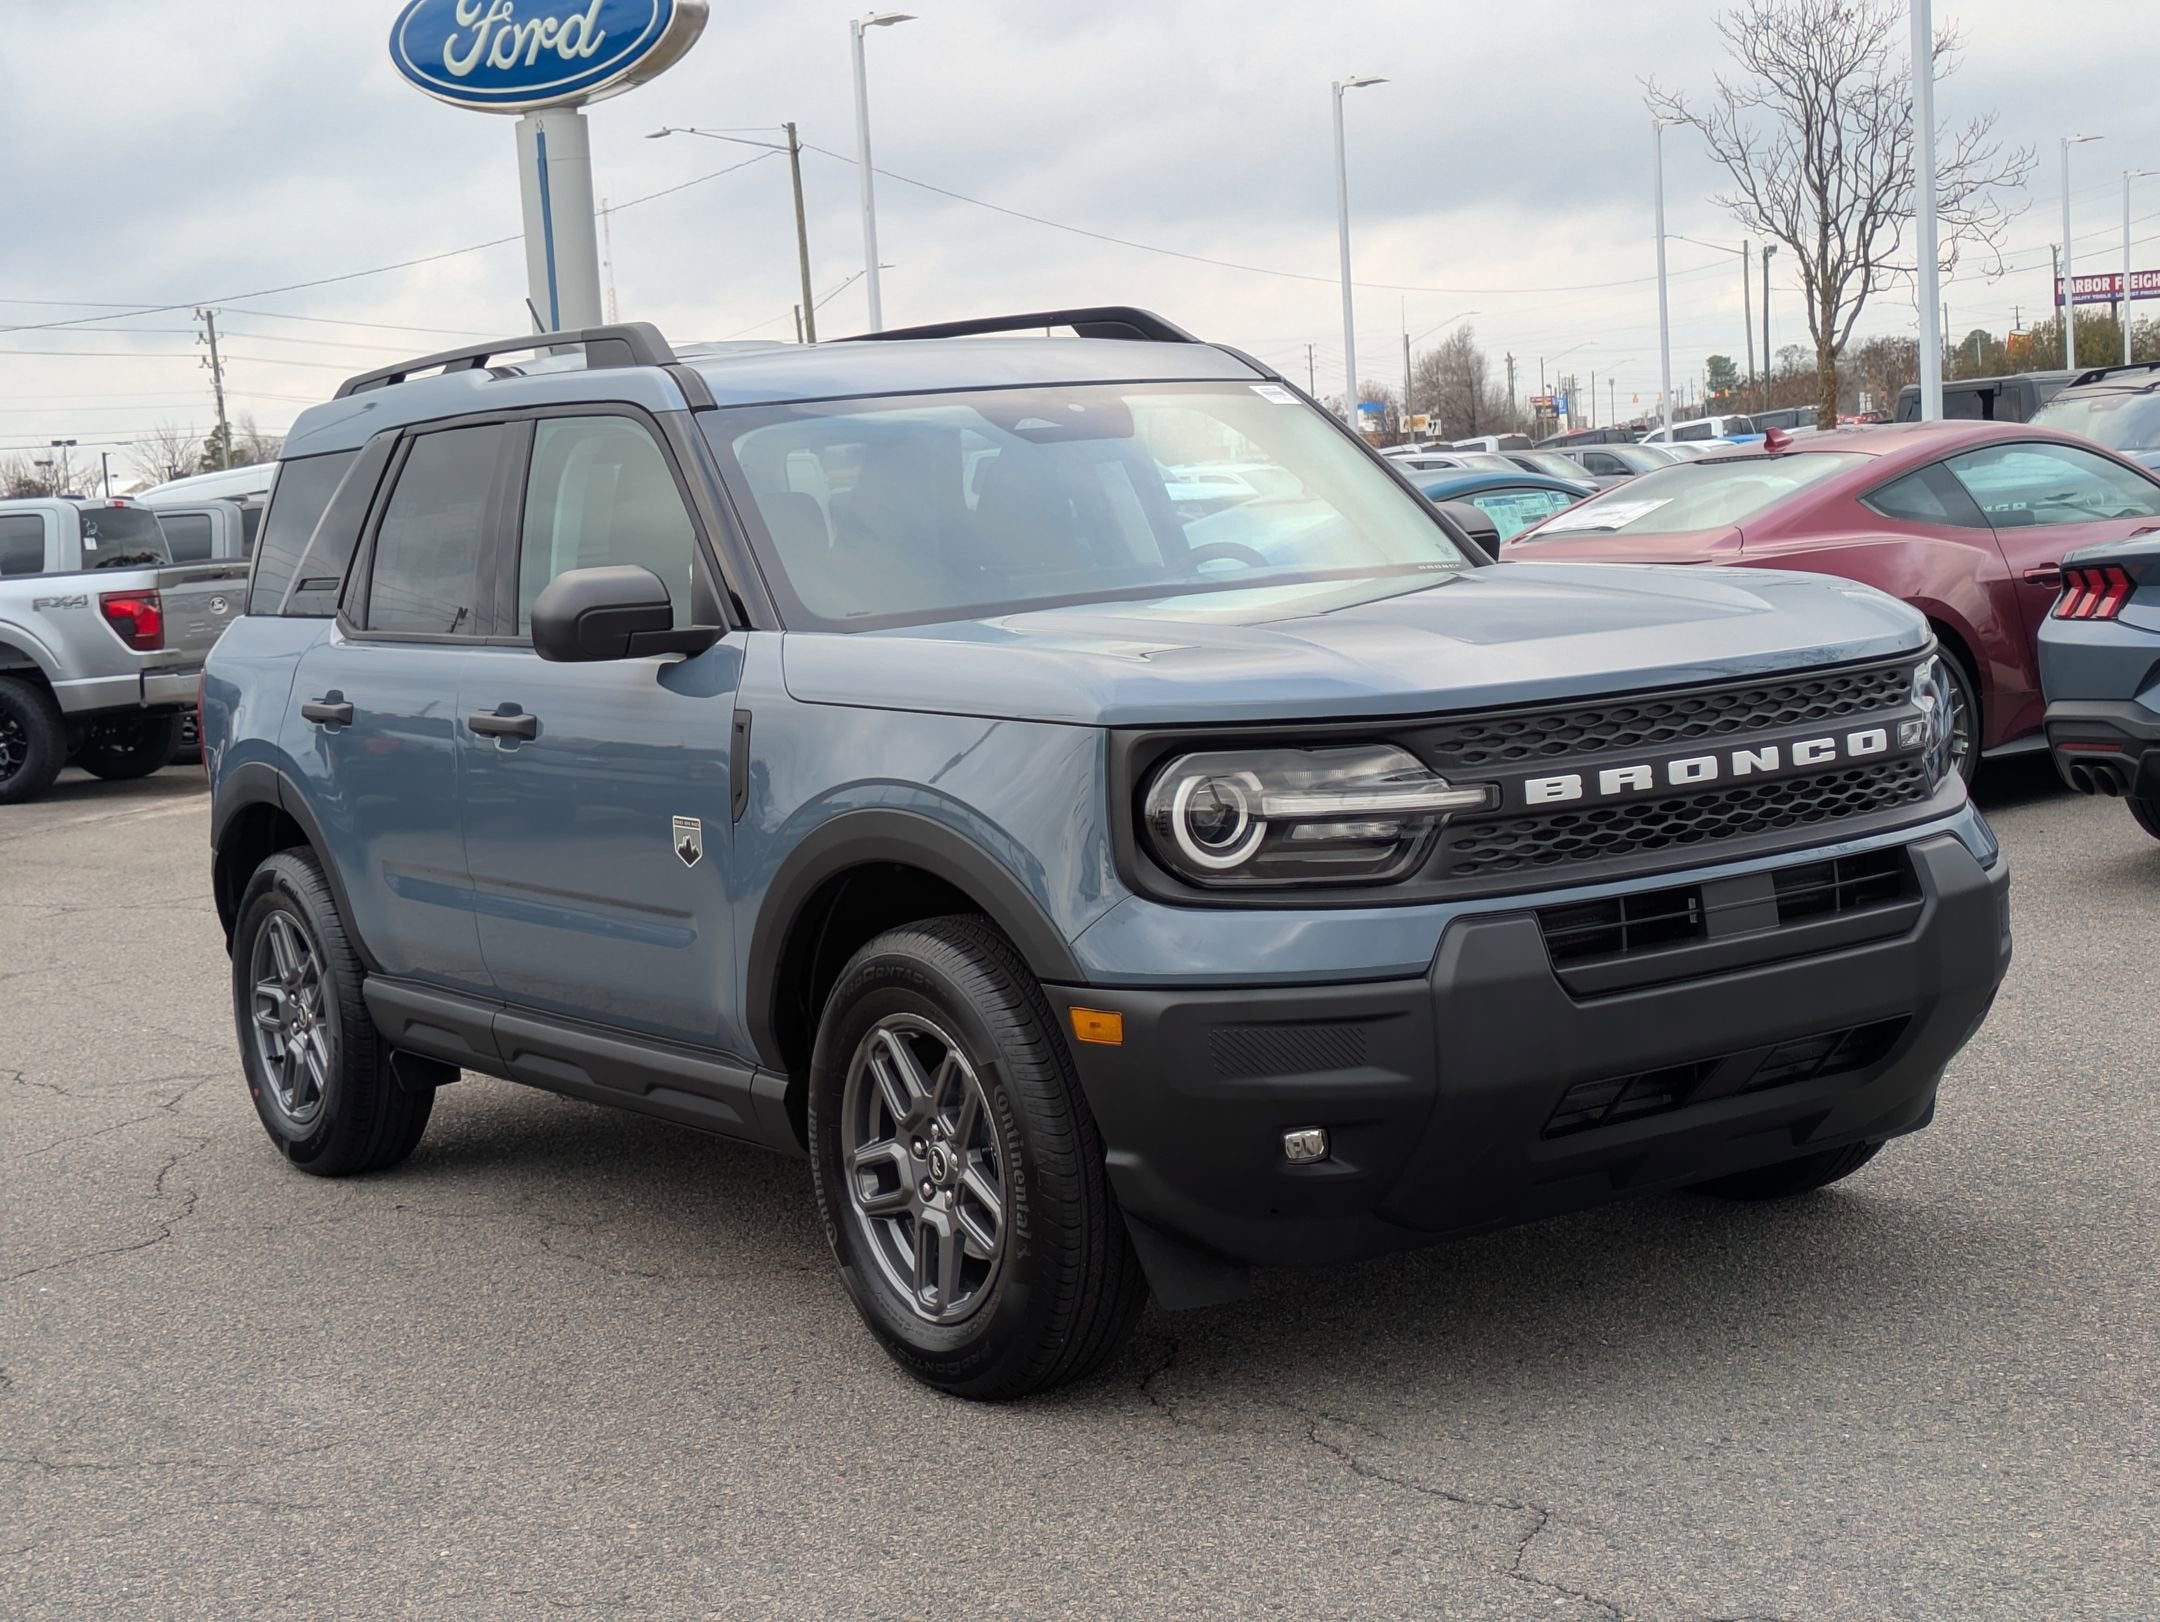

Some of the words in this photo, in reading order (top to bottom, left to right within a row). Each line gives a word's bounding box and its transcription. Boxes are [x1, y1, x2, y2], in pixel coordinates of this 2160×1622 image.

[443, 0, 606, 77] Ford
[32, 594, 88, 612] FX4
[1525, 727, 1888, 805] BRONCO
[993, 1083, 1032, 1240] Continental
